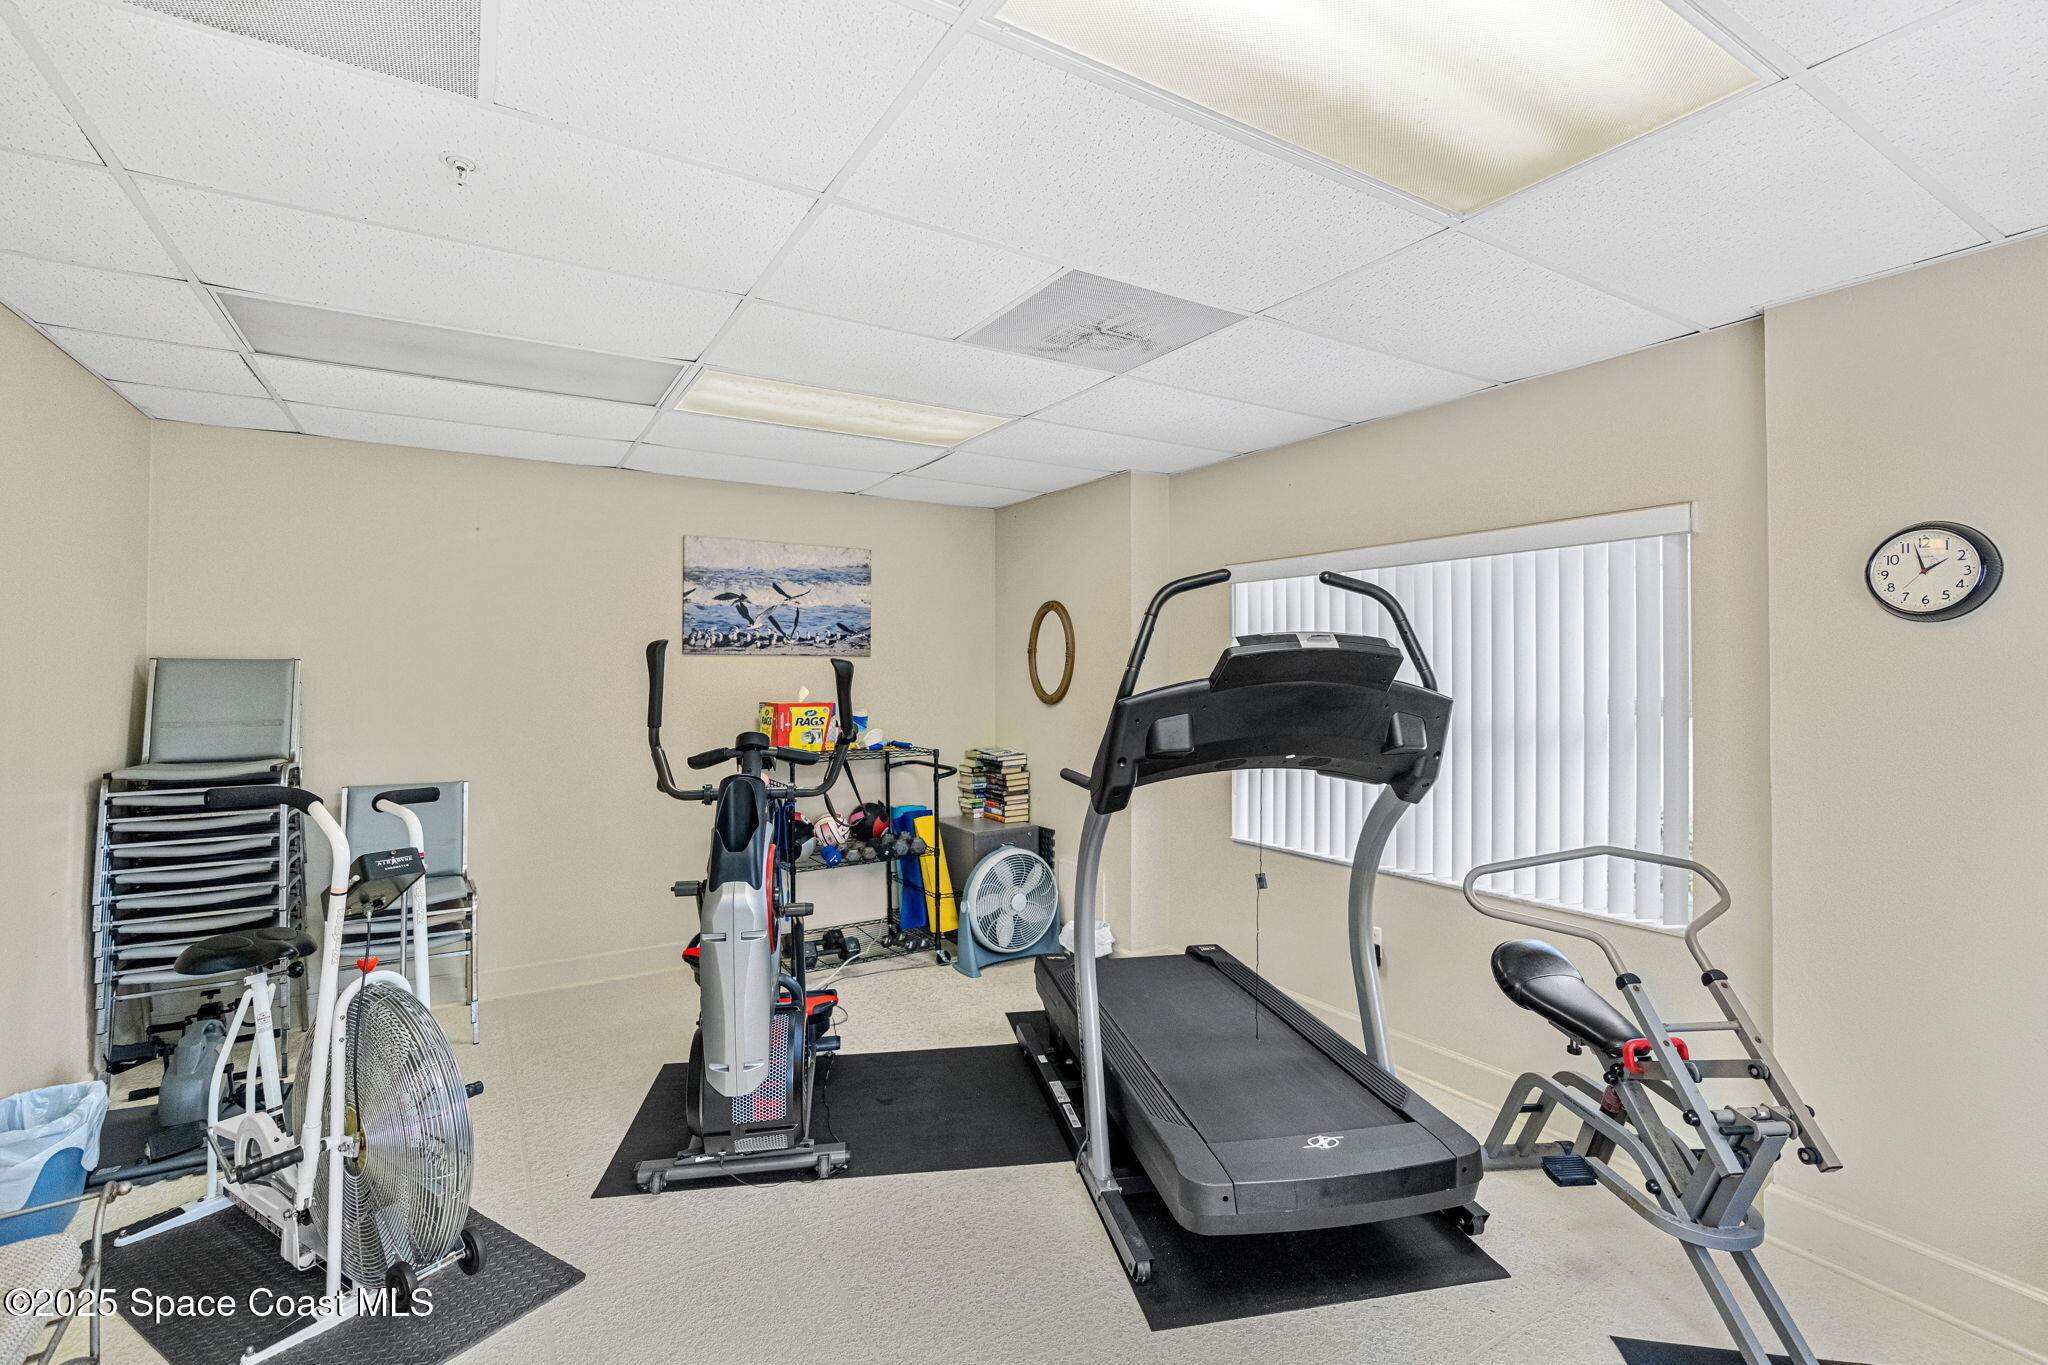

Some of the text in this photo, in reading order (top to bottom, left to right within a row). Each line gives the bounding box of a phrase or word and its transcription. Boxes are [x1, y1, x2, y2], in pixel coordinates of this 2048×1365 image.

[1901, 543, 1910, 553] 11
[1918, 537, 1931, 549] 12
[1886, 555, 1899, 566] 10
[1957, 550, 1966, 561] 2
[1881, 570, 1889, 580] 9
[1964, 565, 1972, 576] 3
[1887, 583, 1896, 593] 8
[1956, 579, 1965, 589] 4
[1902, 592, 1909, 602] 7
[1921, 595, 1930, 605] 6
[1941, 590, 1950, 600] 5
[795, 717, 825, 726] RAGS
